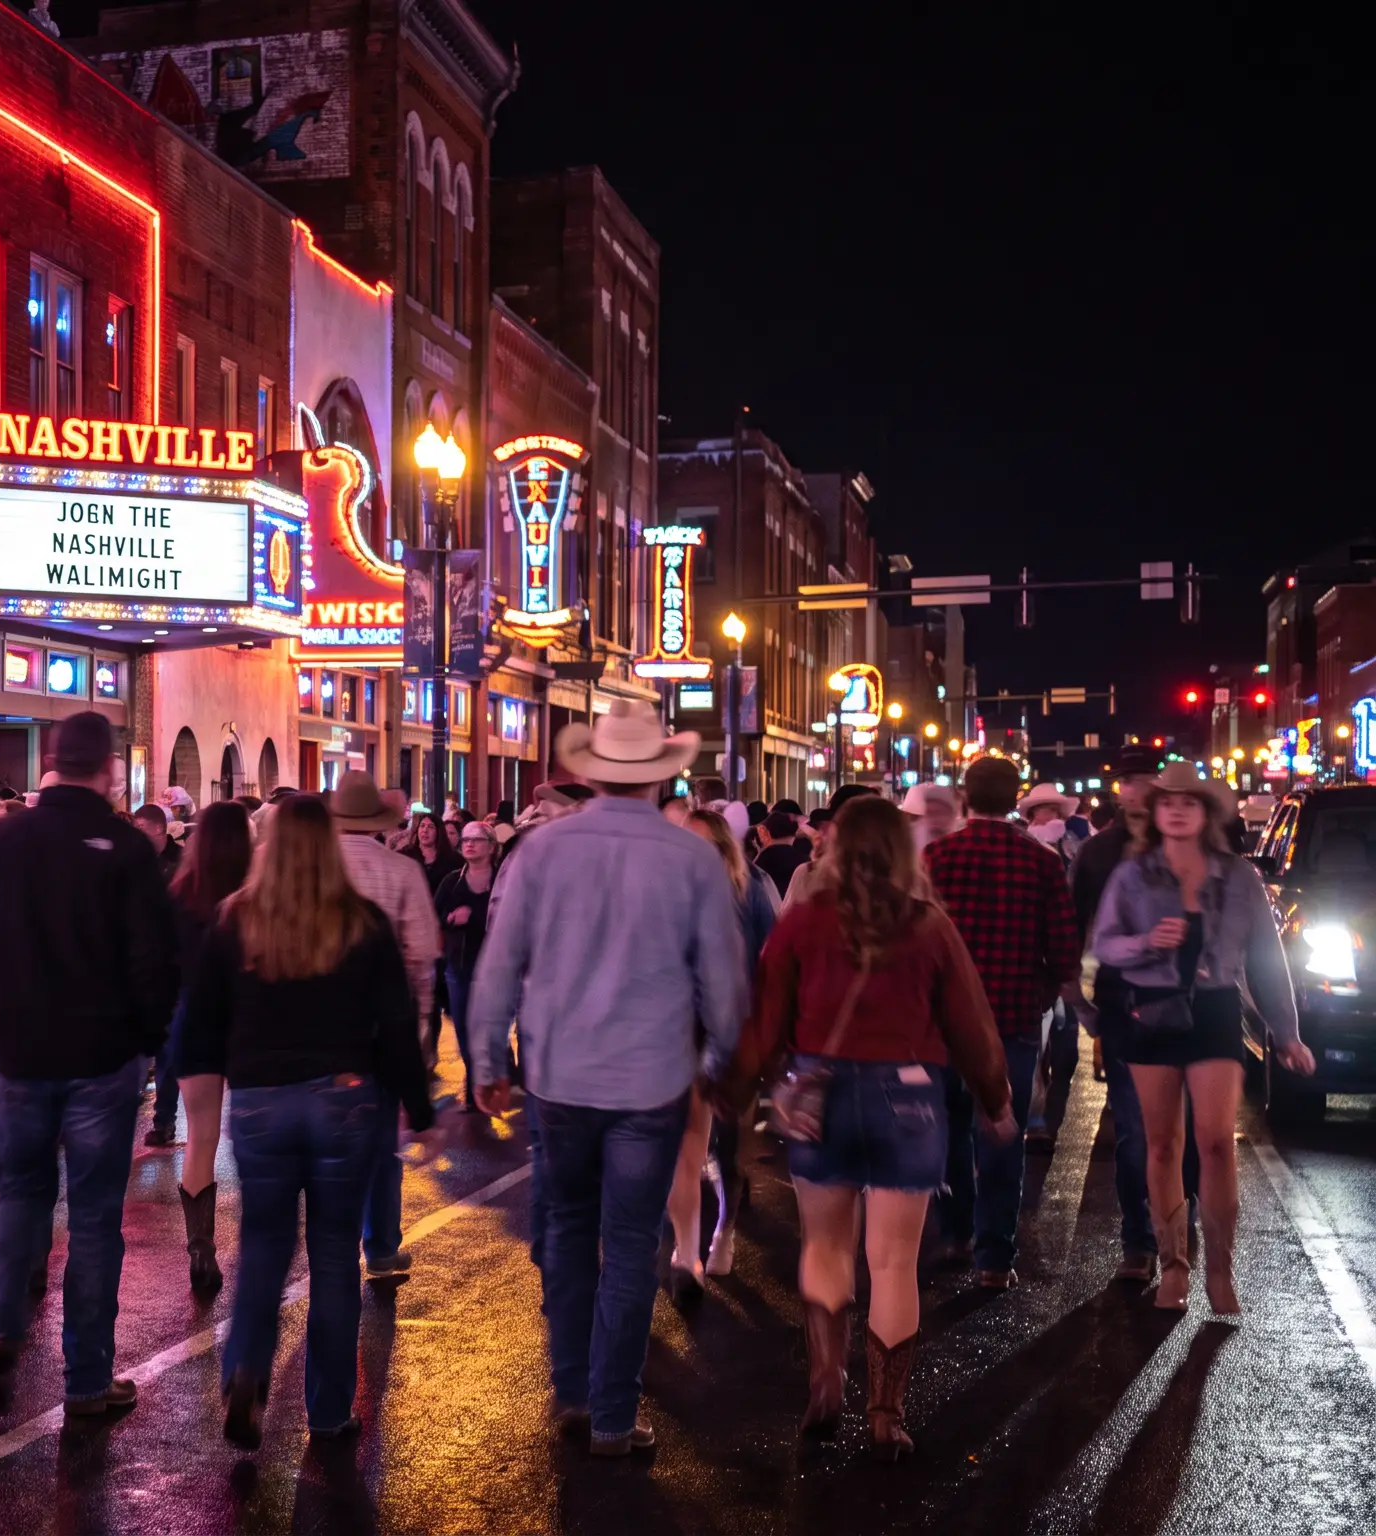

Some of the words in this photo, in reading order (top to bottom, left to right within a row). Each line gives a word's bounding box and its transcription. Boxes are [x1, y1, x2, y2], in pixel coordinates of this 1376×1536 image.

[128, 506, 172, 529] THE
[52, 532, 175, 560] NASHVILLE
[46, 563, 182, 591] WALIMIGHT
